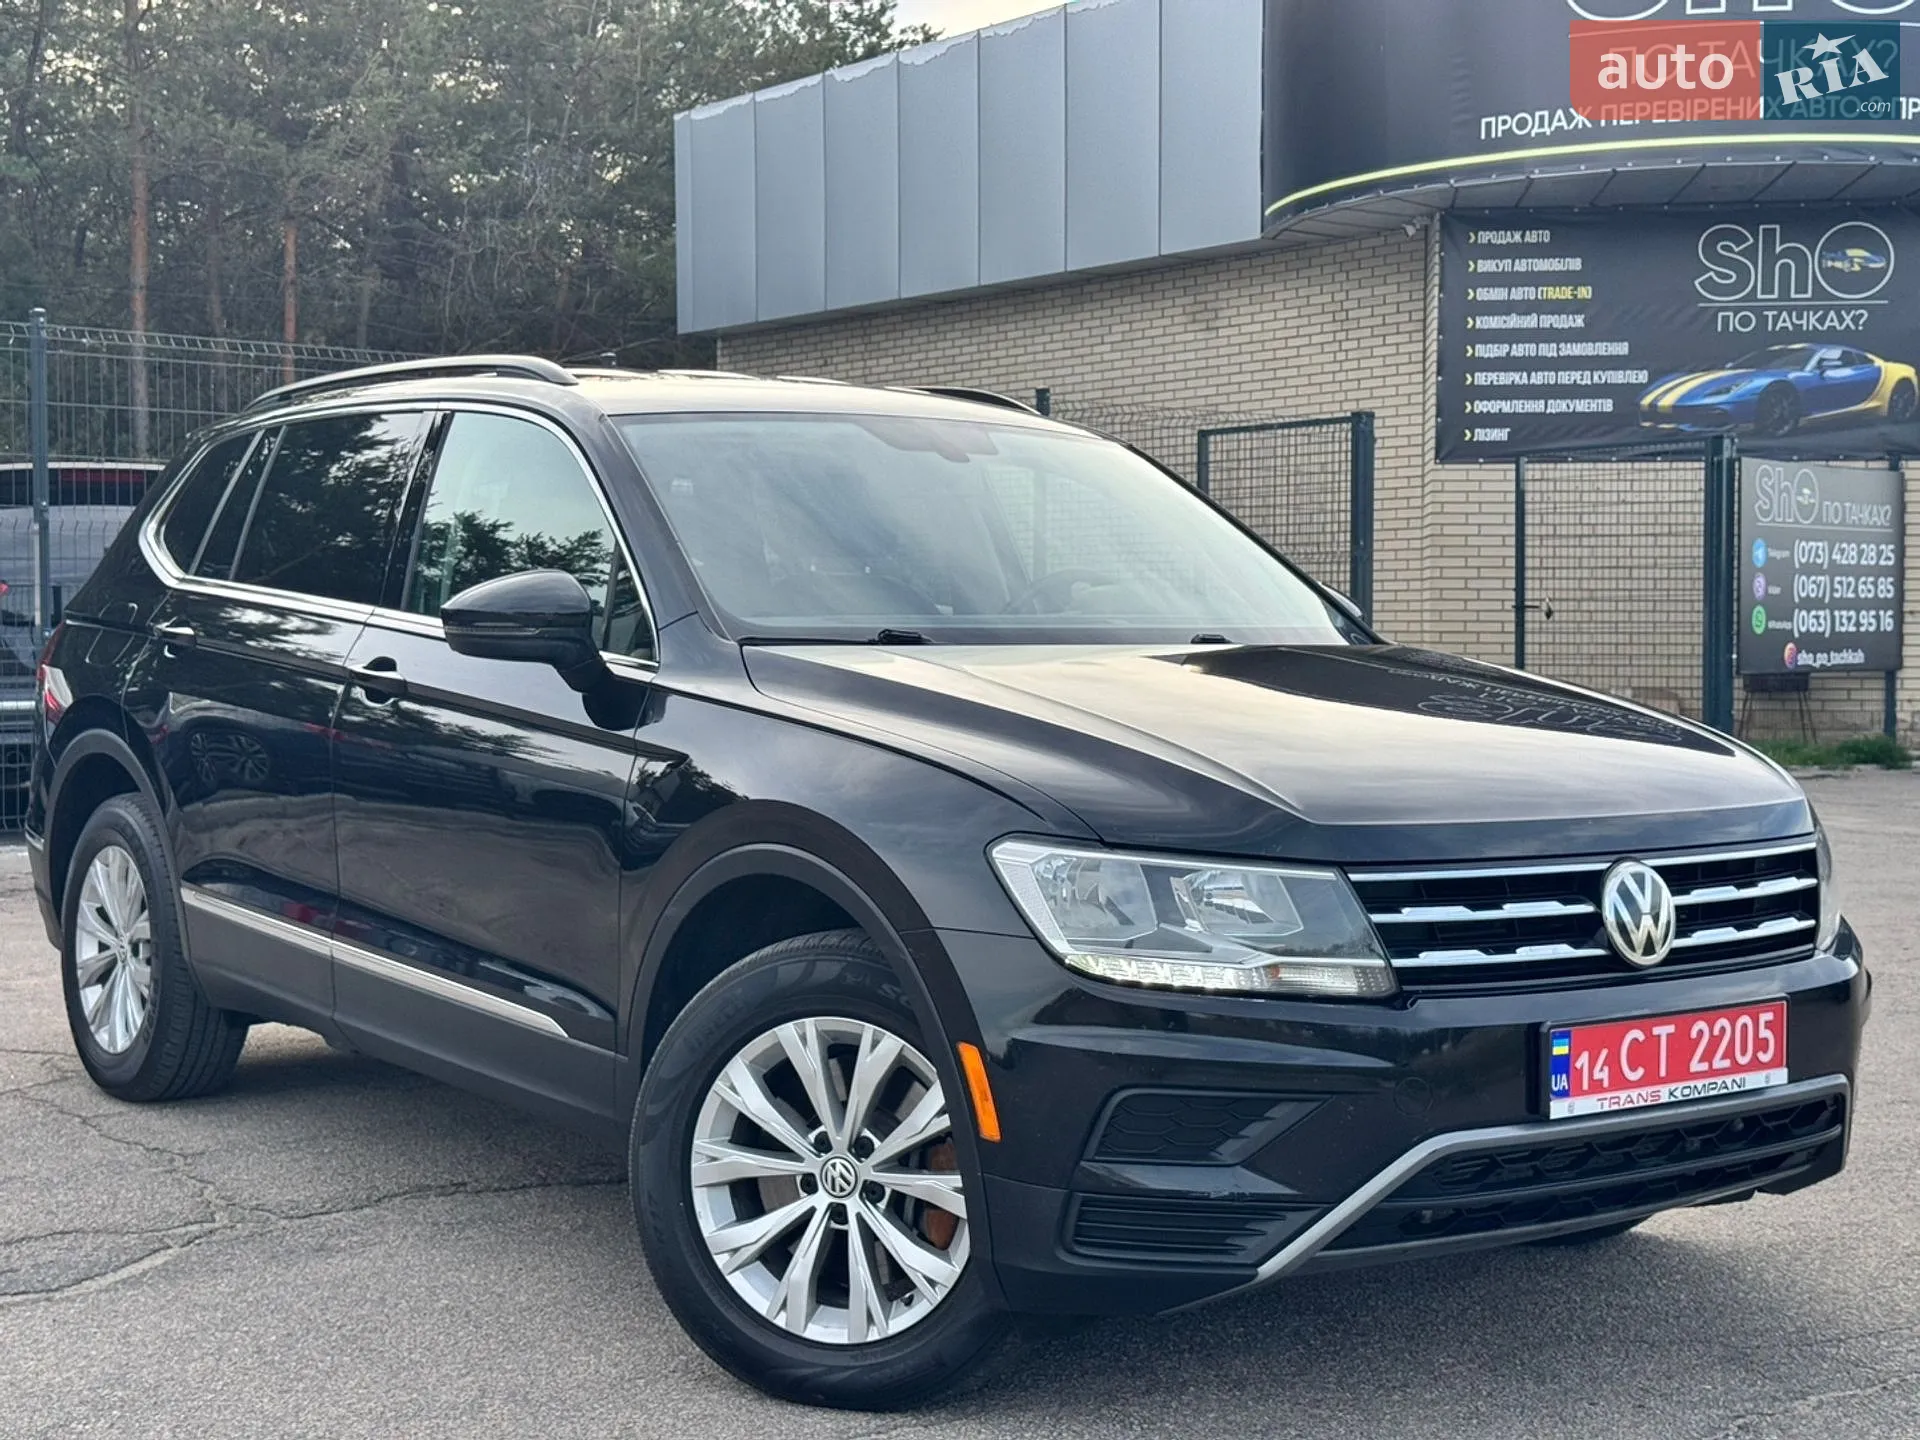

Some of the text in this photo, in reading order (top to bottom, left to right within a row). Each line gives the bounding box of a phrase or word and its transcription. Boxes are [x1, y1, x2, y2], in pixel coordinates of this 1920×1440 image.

[1480, 106, 1593, 140] ПРОДАЖ
[1477, 230, 1550, 244] ПРОДАЖ АВТО
[1477, 258, 1582, 273] ВИКУП АВТОМОБІЛІВ
[1476, 287, 1508, 301] ОБМІН
[1509, 287, 1536, 300] АВТО
[1475, 312, 1585, 329] КОМІСІЙНИЙ ПРОДАЖ
[1717, 309, 1869, 332] ПО ТАЧКАХ?
[1474, 342, 1629, 358] ПІДБІР АВТО ПІД ЗАМОВЛЕННЯ
[1474, 370, 1648, 386] ПЕРЕВІРКА АВТО ПЕРЕД КУПІВЛЕЮ
[1473, 399, 1614, 415] ОФОРМЛЕННЯ ДОКУМЕНТІВ
[1473, 428, 1511, 442] ЛІЗИНГ
[1822, 501, 1841, 524] ПО
[1794, 539, 1895, 570] (073) 428 28 25
[1793, 573, 1830, 603] (067)
[1832, 577, 1856, 598] 512
[1858, 577, 1875, 598] 65
[1877, 577, 1894, 598] 85
[1793, 608, 1894, 638] (063) 132 95 16
[1574, 1011, 1775, 1090] 14 CT 2205
[1551, 1074, 1568, 1091] UA
[1596, 1077, 1746, 1110] TRANS KOMPANI
